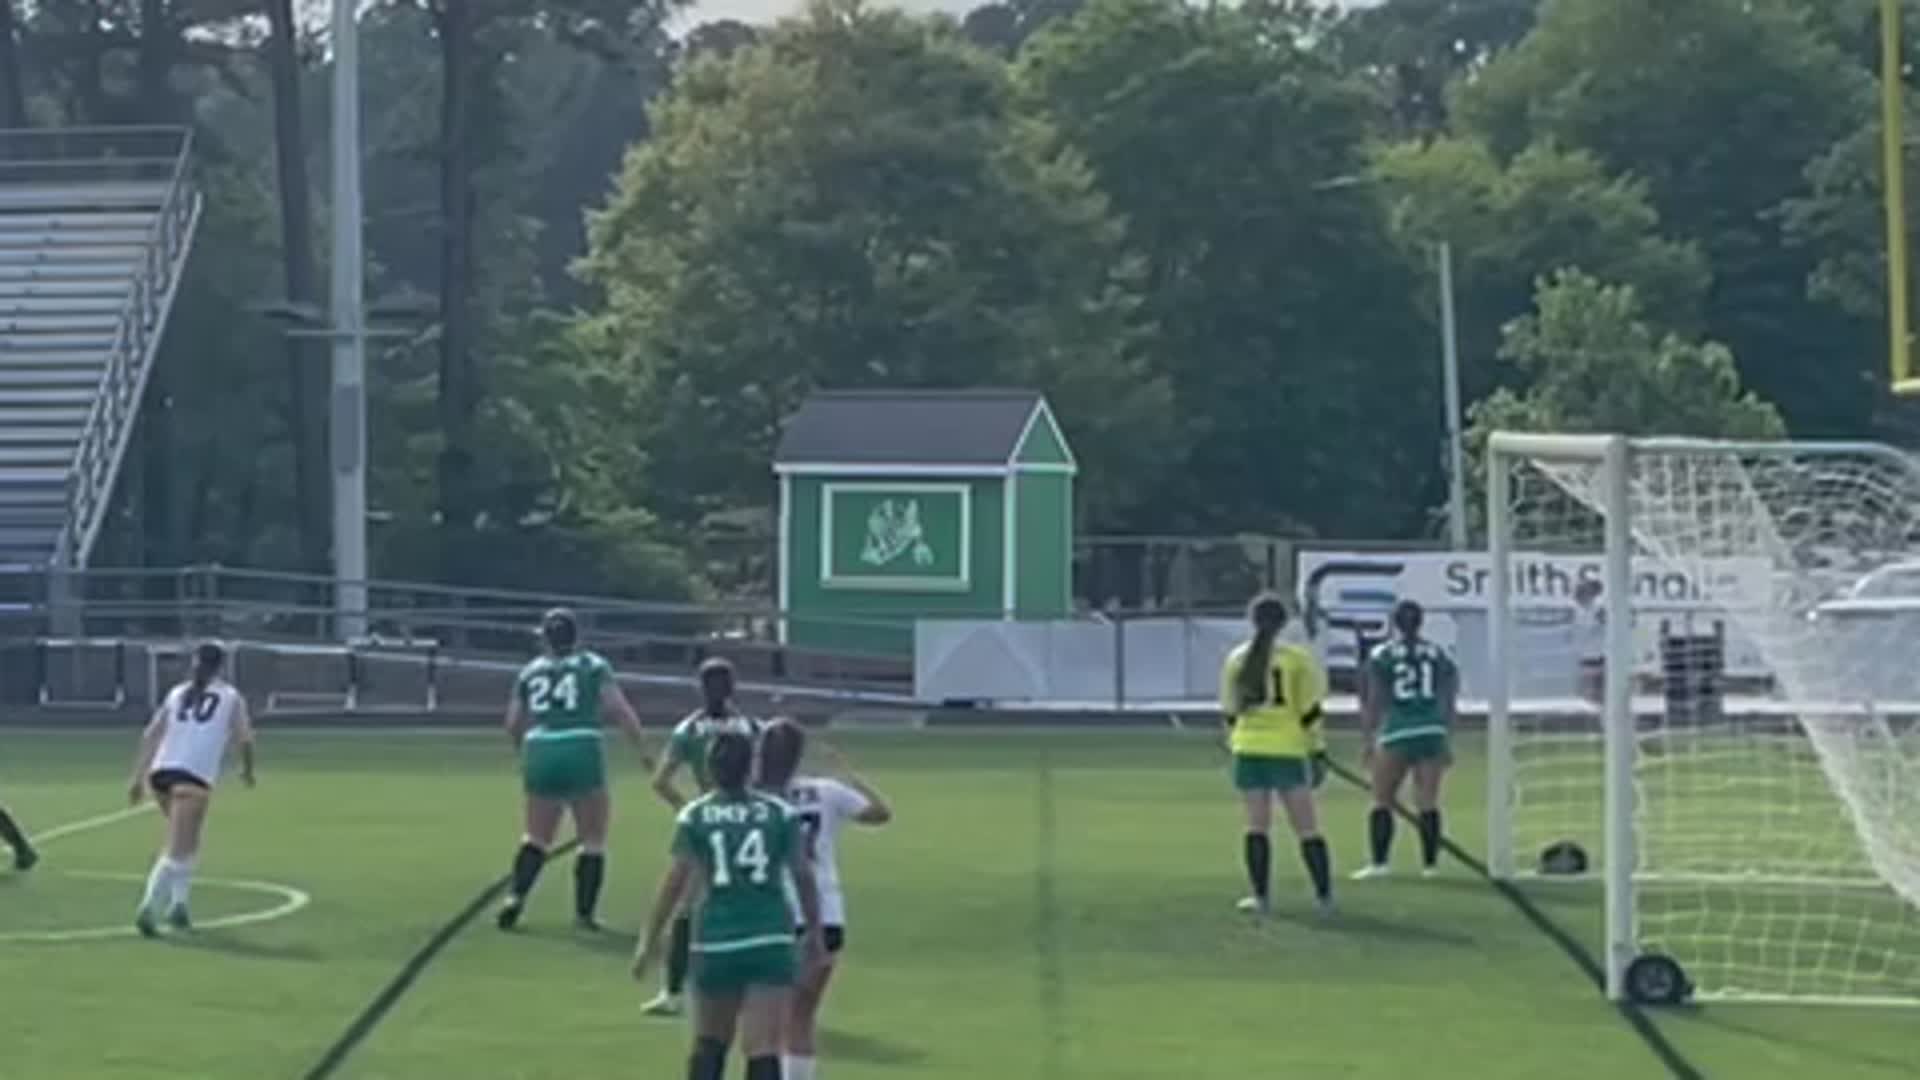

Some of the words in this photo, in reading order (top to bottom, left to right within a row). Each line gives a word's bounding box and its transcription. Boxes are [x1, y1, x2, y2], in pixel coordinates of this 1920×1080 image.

[527, 673, 578, 711] 24
[1395, 663, 1434, 699] 21
[709, 828, 769, 885] 14
